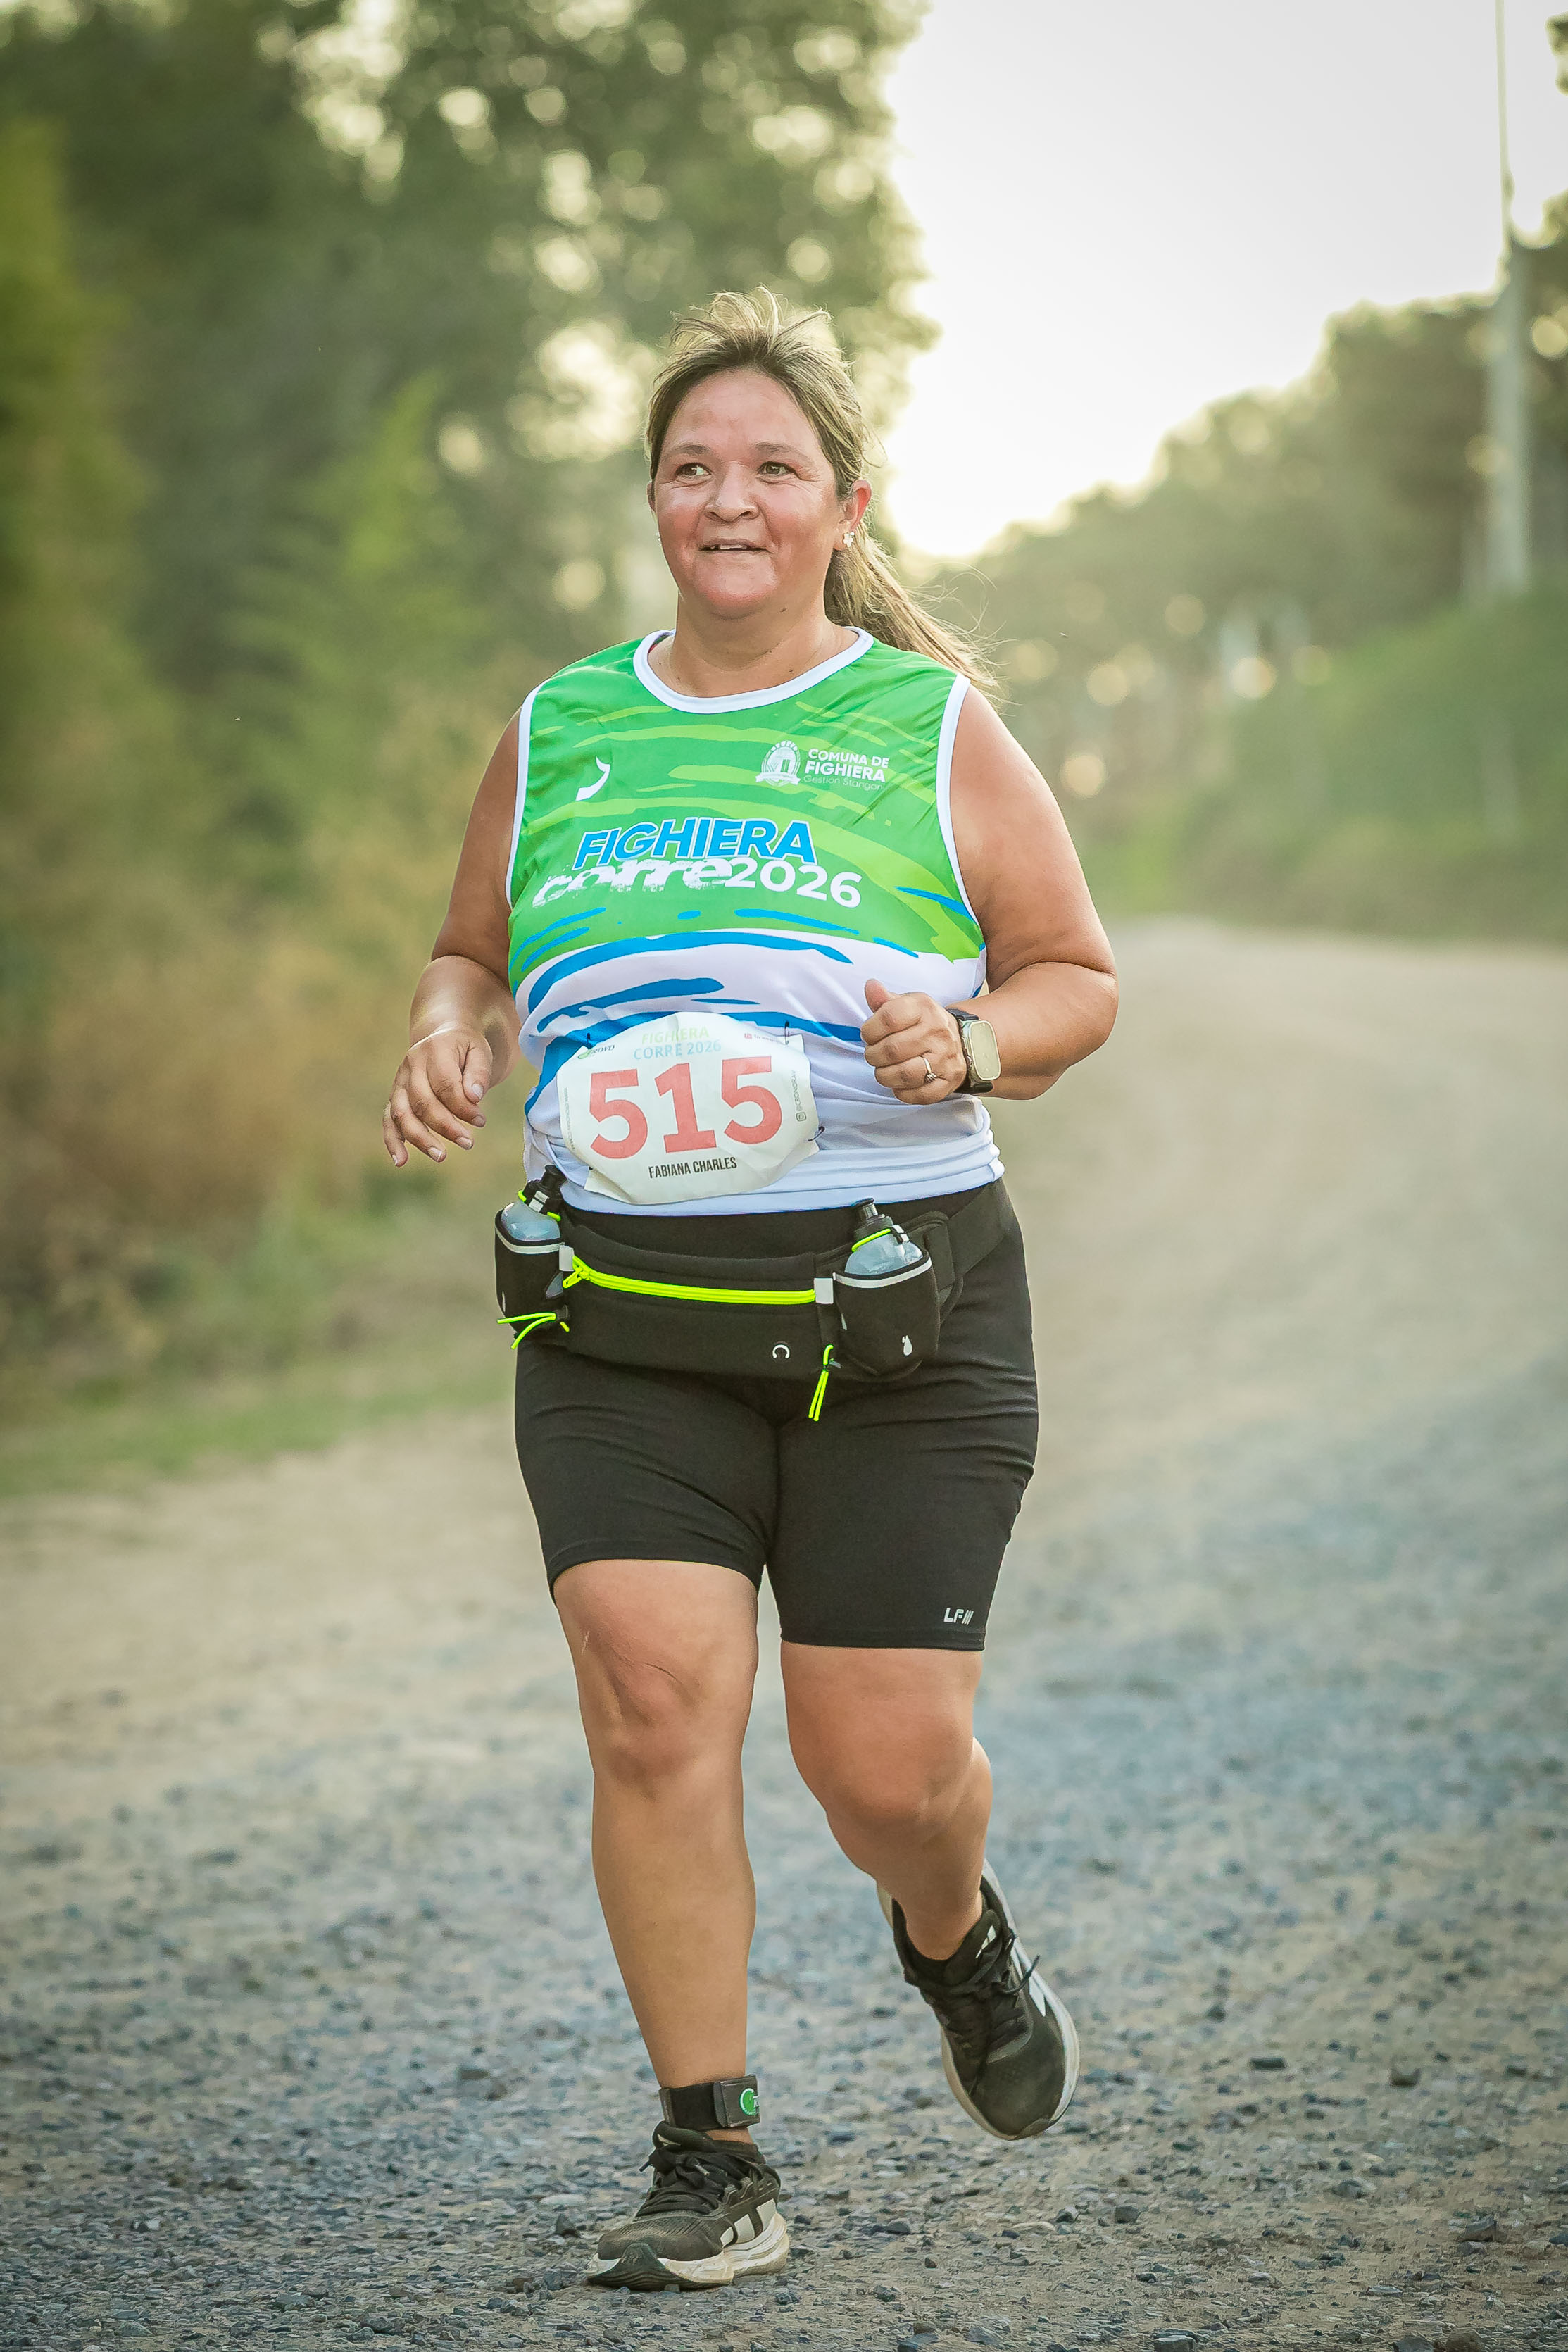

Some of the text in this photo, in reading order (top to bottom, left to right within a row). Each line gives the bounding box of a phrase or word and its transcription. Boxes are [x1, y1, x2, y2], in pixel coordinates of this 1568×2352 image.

[808, 748, 890, 769] COMUNA DE
[804, 760, 886, 783] FIGHIERA
[571, 817, 818, 870] FIGHIERA
[641, 1027, 710, 1044] FIGHIERA
[634, 1039, 722, 1060] CORRE 2026
[589, 1056, 782, 1159] 515
[648, 1156, 737, 1178] FABIANA CHARLES
